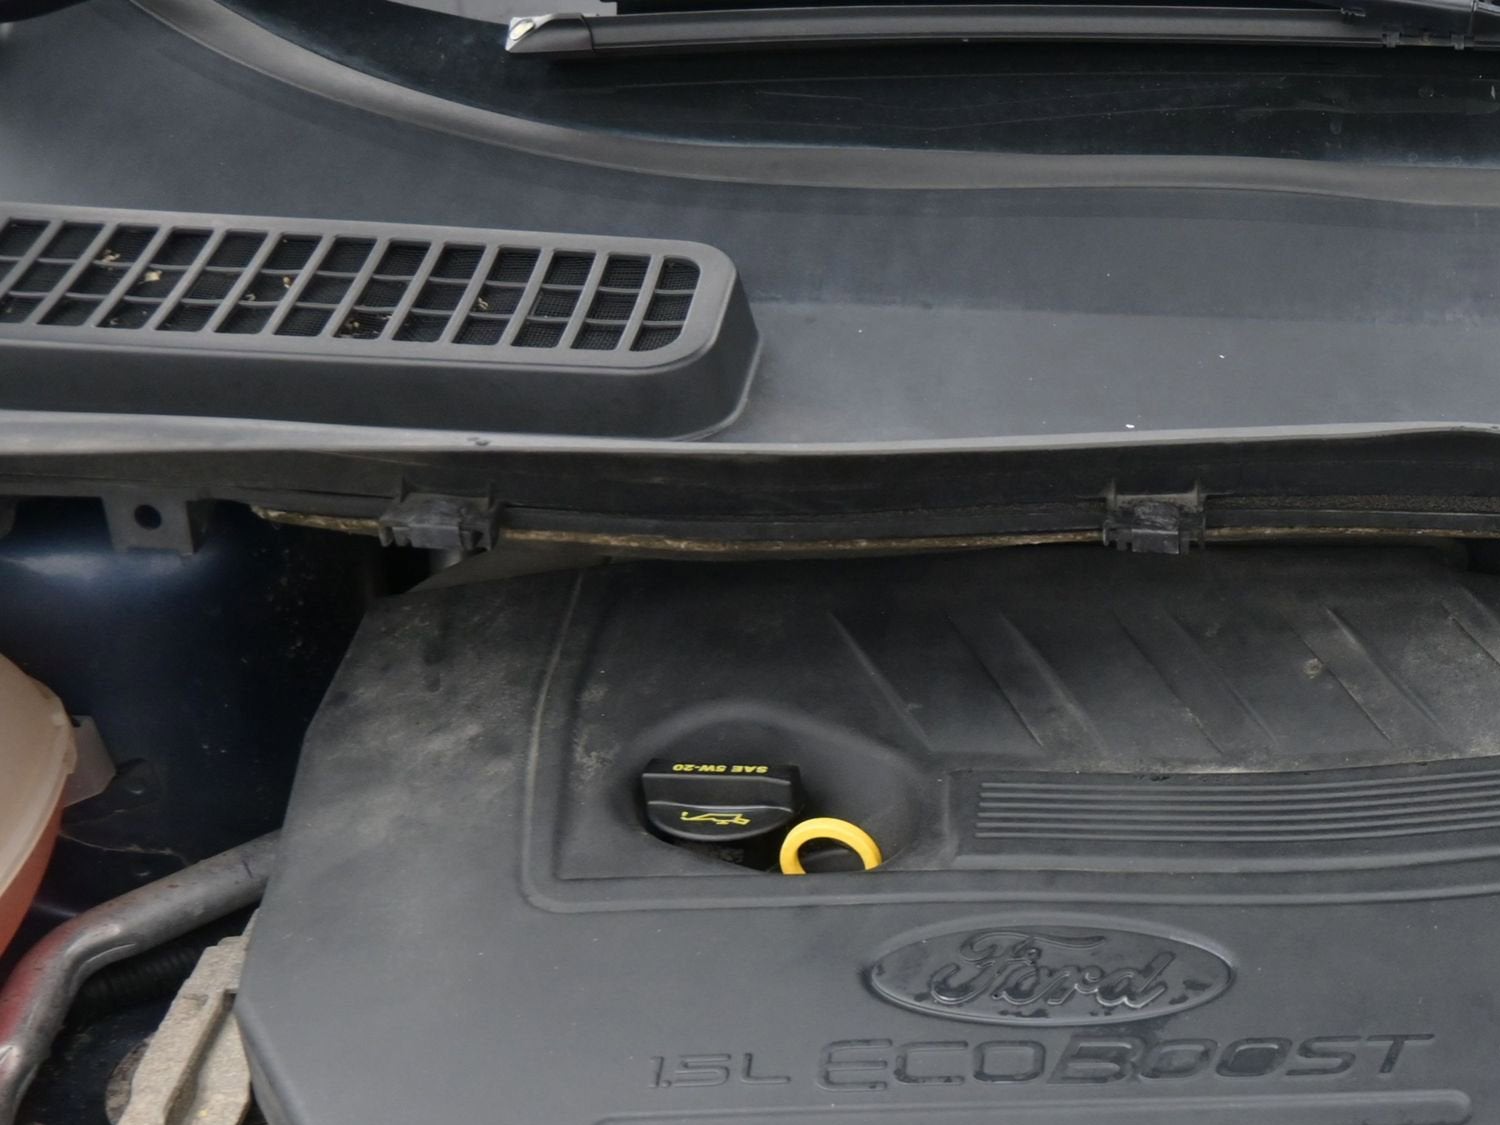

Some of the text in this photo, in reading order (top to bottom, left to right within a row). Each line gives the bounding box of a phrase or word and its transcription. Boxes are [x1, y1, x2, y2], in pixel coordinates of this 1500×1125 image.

[672, 763, 769, 774] SAE 5W-20
[930, 930, 1172, 1009] Ford
[647, 1052, 792, 1091] 1.5L
